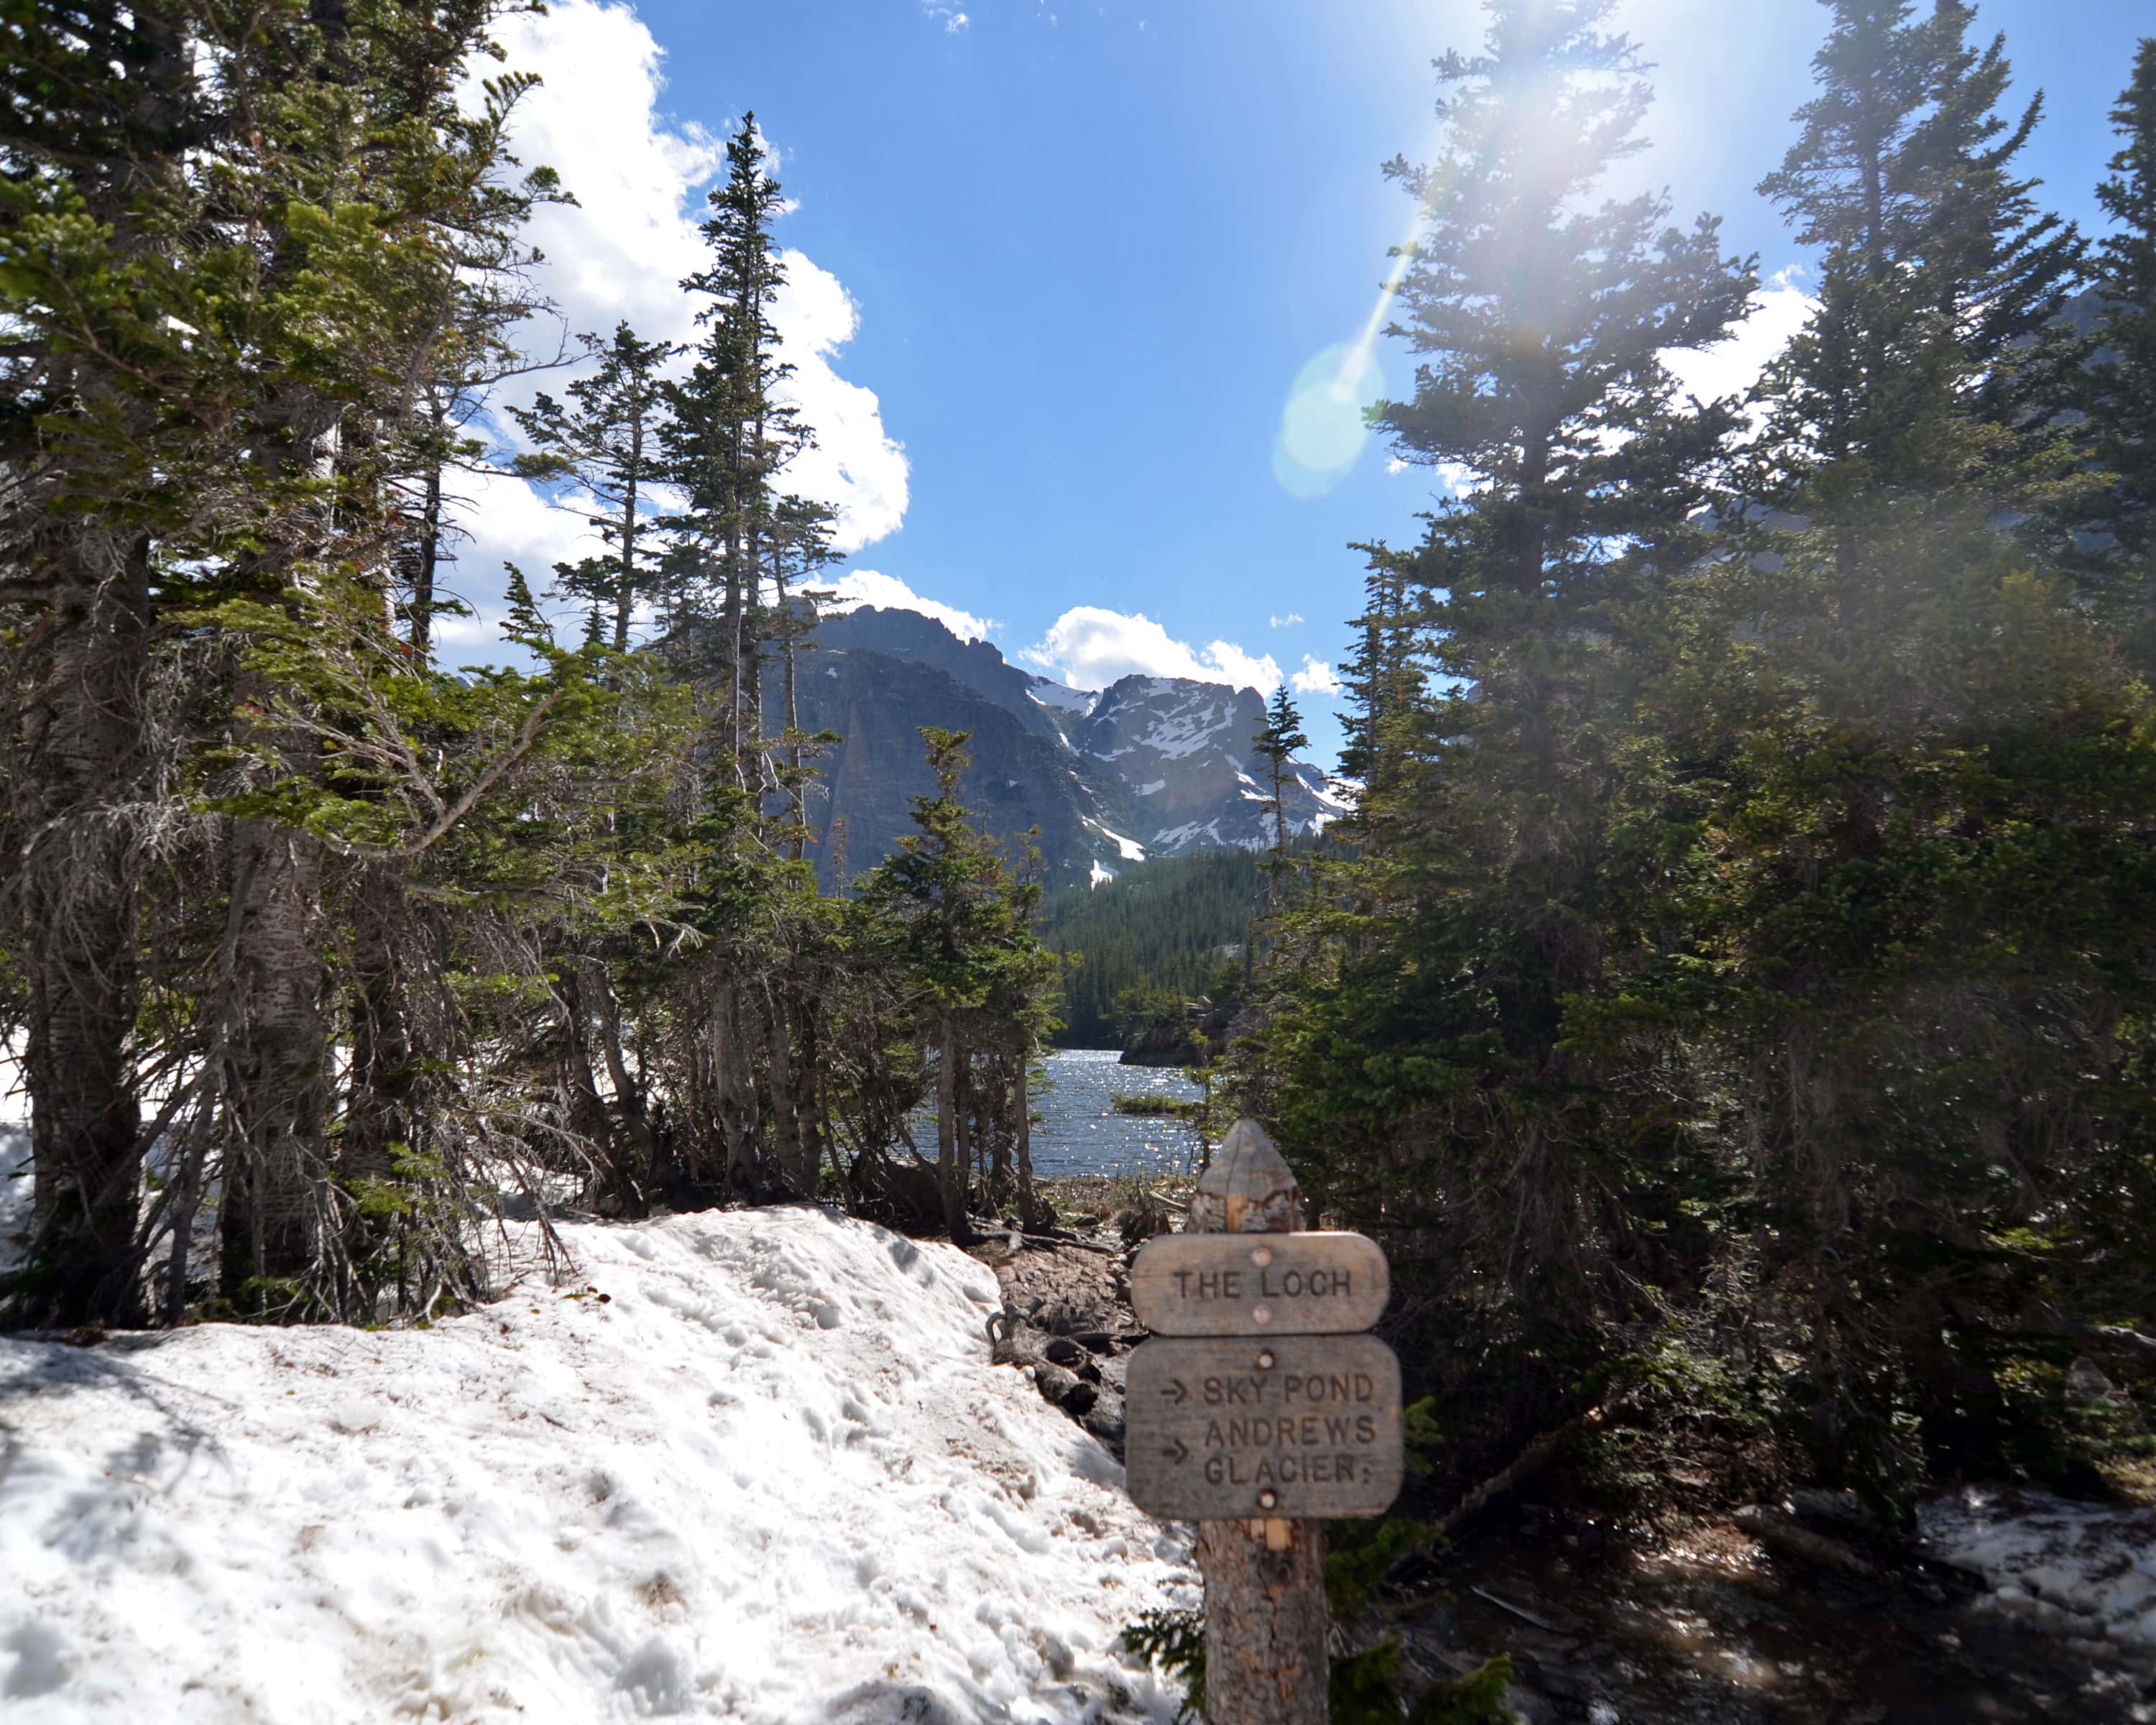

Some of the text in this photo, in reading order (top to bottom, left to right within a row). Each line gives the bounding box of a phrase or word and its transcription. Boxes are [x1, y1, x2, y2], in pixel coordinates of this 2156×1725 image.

[1175, 1270, 1351, 1299] THE LOCH
[1204, 1374, 1373, 1404] SKY POND
[1204, 1415, 1377, 1447] ANDREWS
